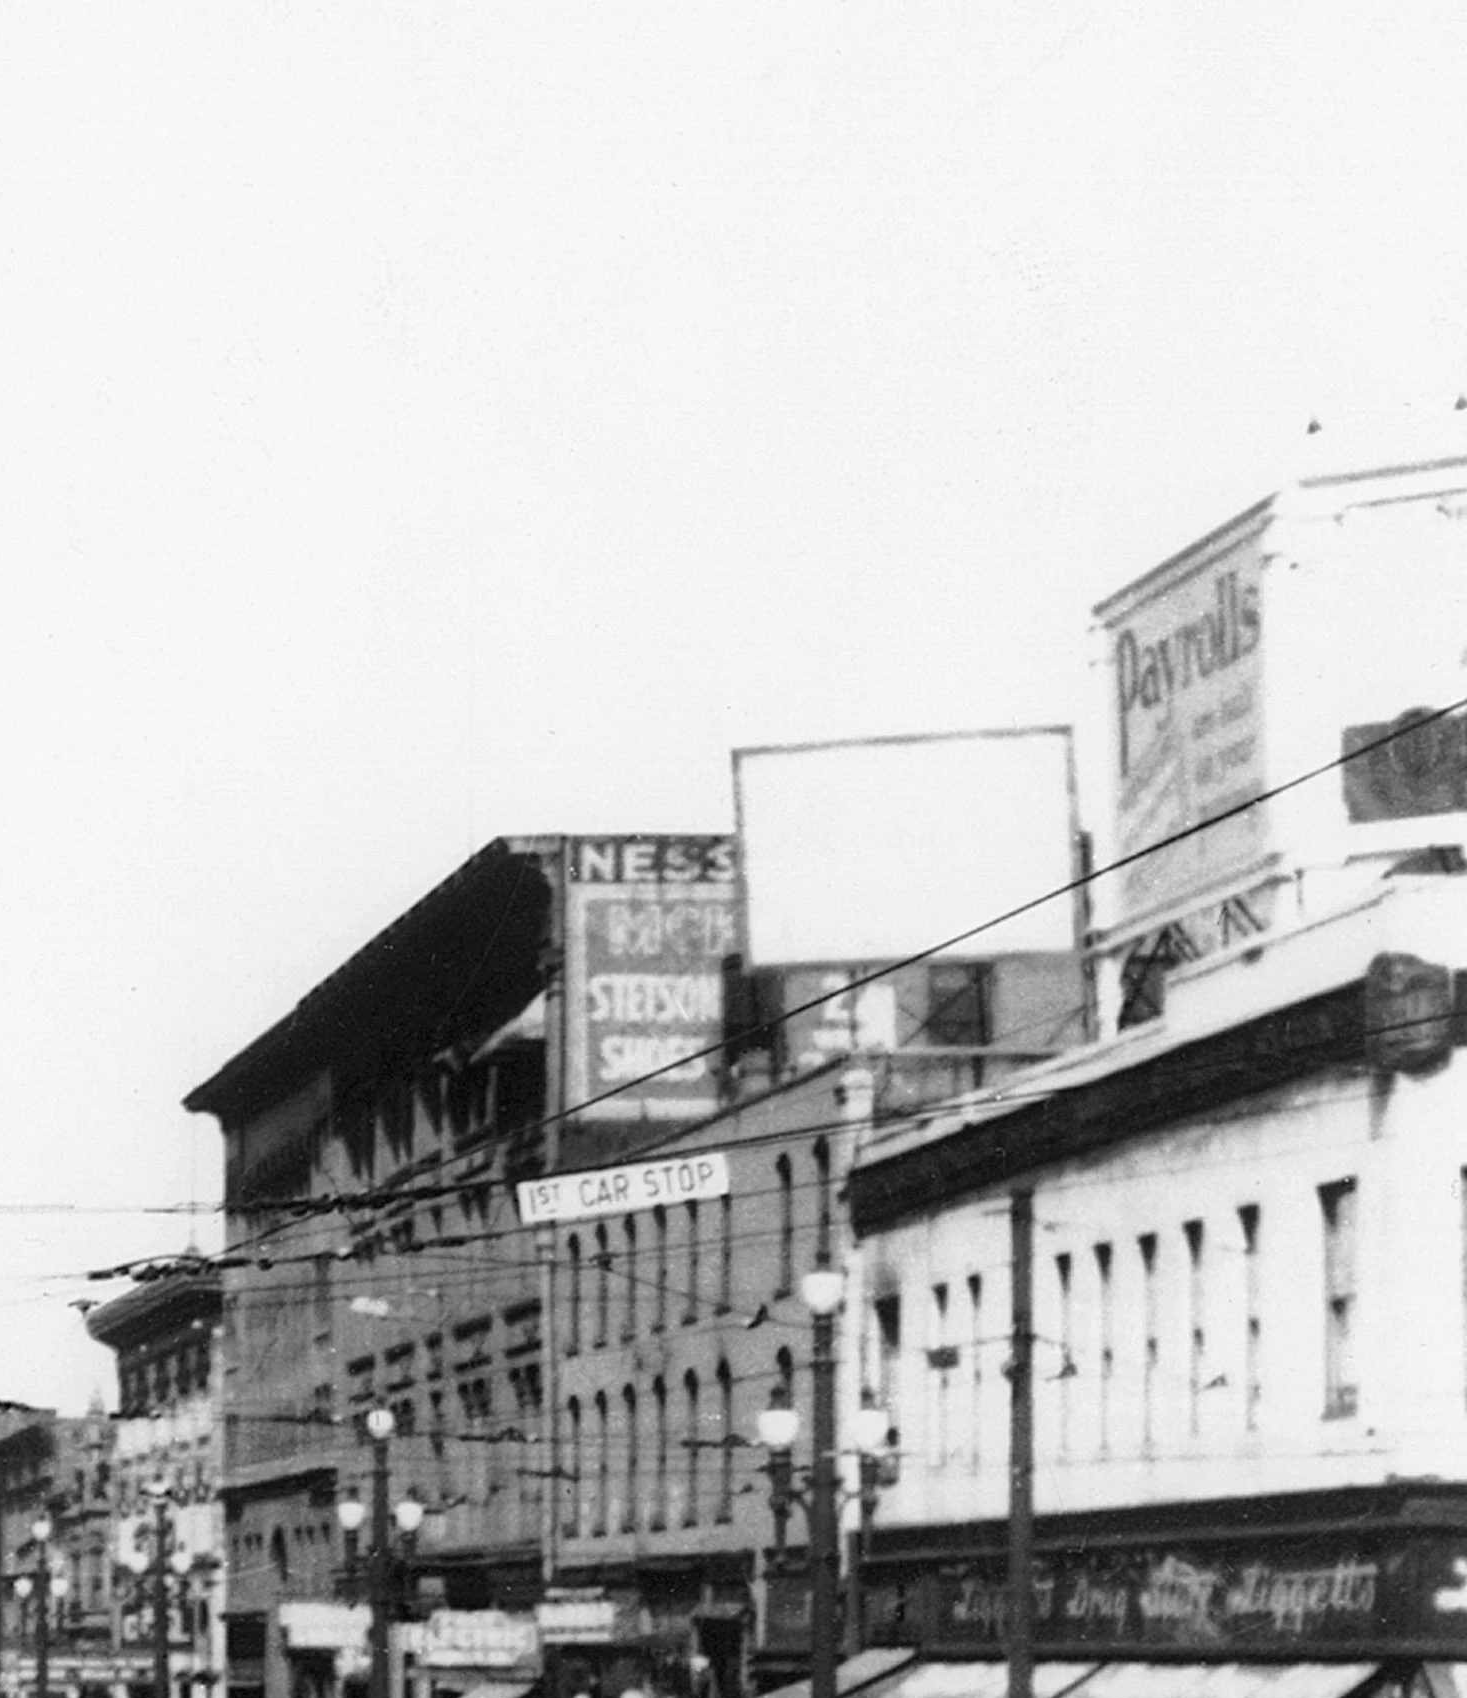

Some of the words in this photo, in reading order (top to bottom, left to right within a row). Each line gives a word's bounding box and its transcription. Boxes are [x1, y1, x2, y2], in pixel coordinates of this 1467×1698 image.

[1116, 571, 1262, 777] Payrolls
[588, 972, 723, 1024] STETSON
[528, 1183, 561, 1215] 1ST
[577, 1173, 630, 1208] CAR
[642, 1160, 714, 1199] STOP
